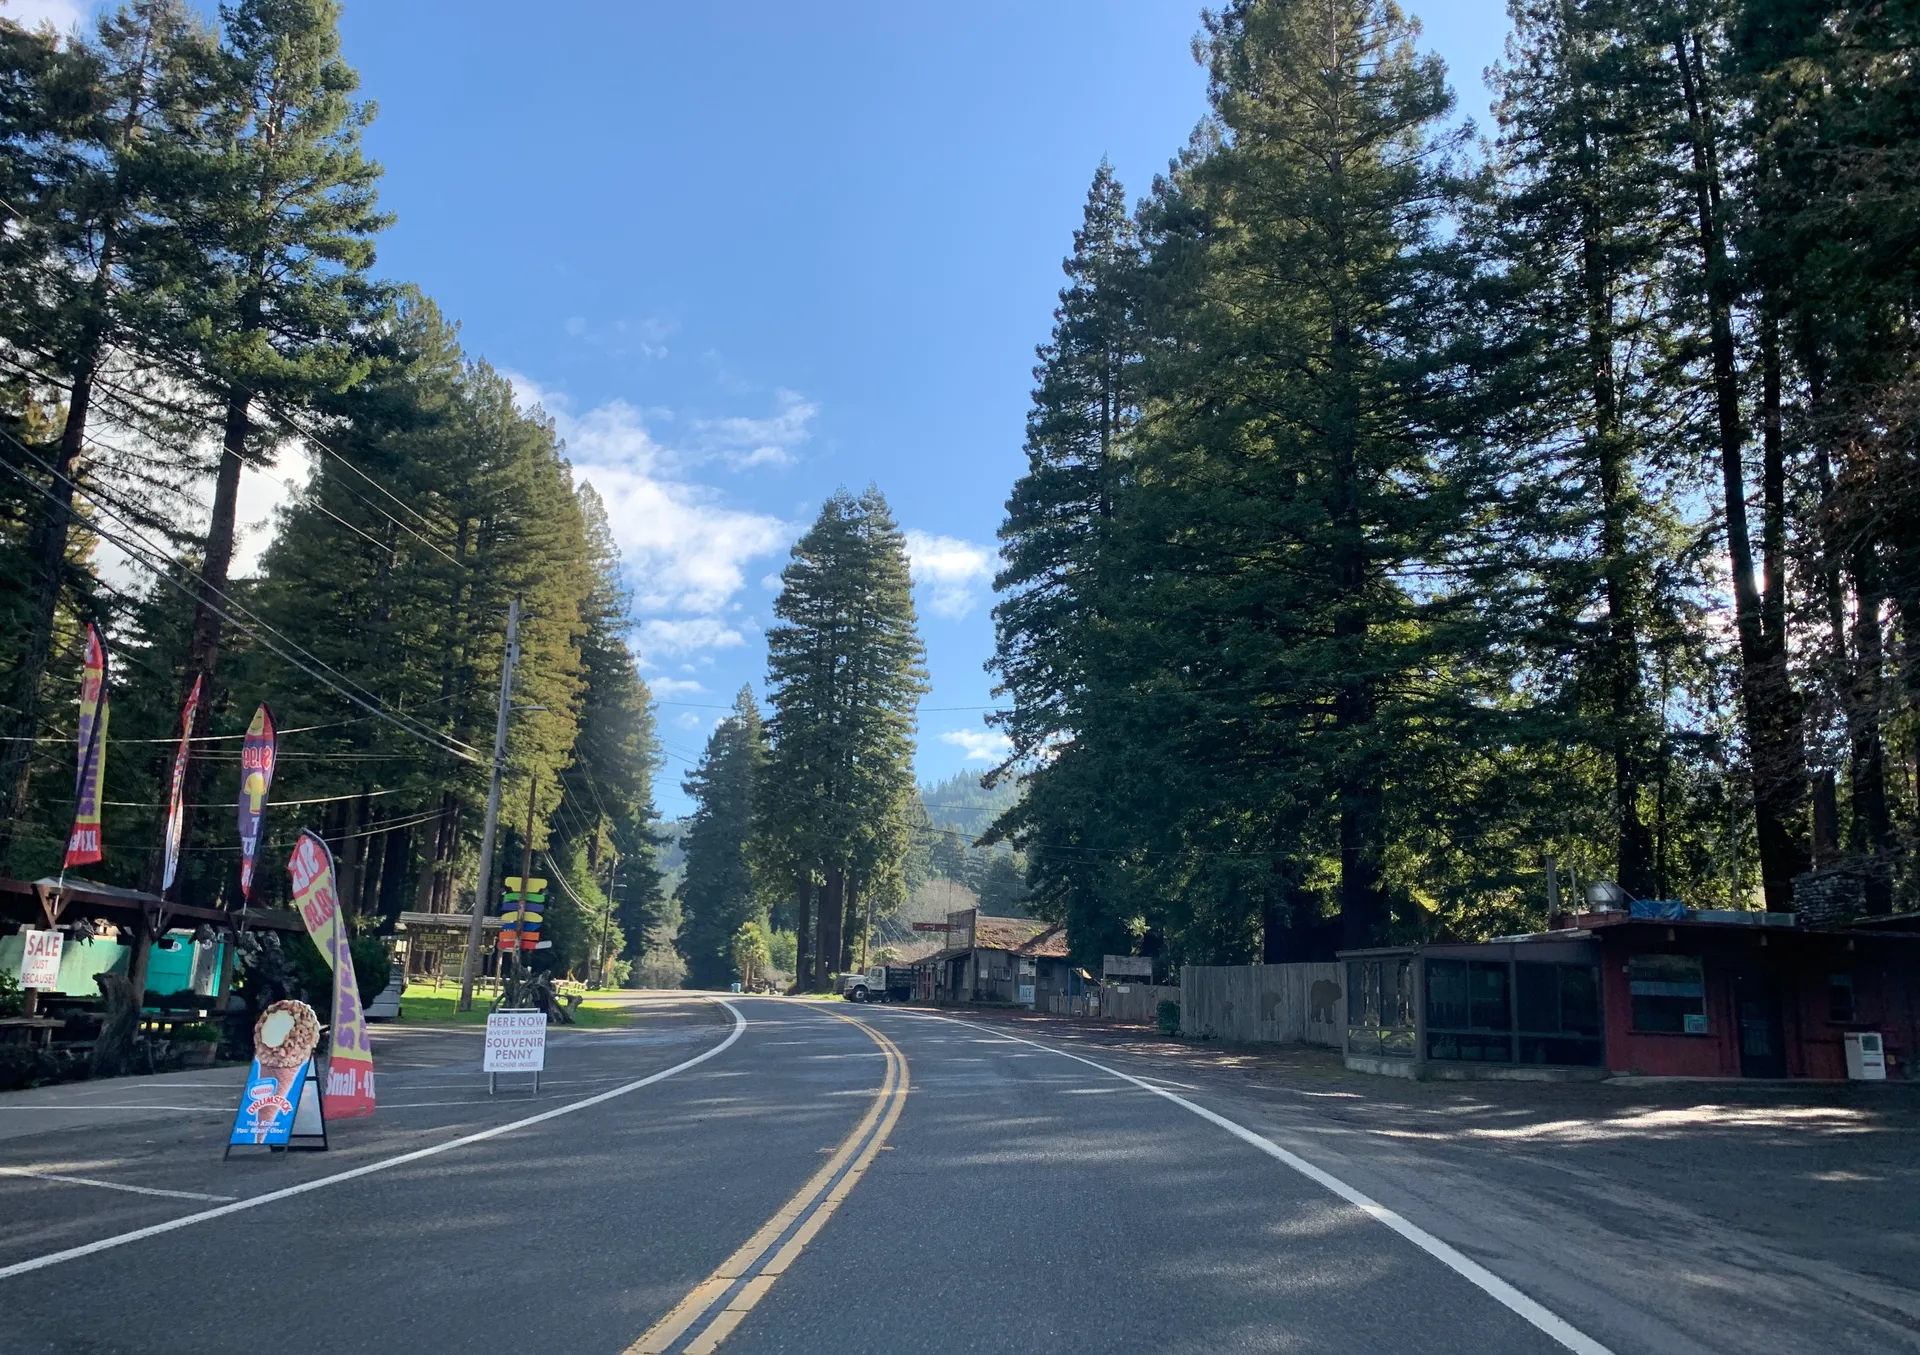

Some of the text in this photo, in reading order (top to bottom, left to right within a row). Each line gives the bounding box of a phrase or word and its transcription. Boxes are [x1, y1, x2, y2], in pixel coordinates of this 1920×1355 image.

[27, 934, 60, 957] SALE
[32, 960, 49, 969] JUST
[21, 972, 56, 984] BECAUSE!
[489, 1016, 545, 1027] HERE NOW
[487, 1037, 543, 1048] SOUVENIR
[495, 1049, 534, 1060] PENNY
[326, 1066, 356, 1096] Small
[247, 1096, 292, 1114] DRUMSTICK
[250, 1126, 268, 1134] Want
